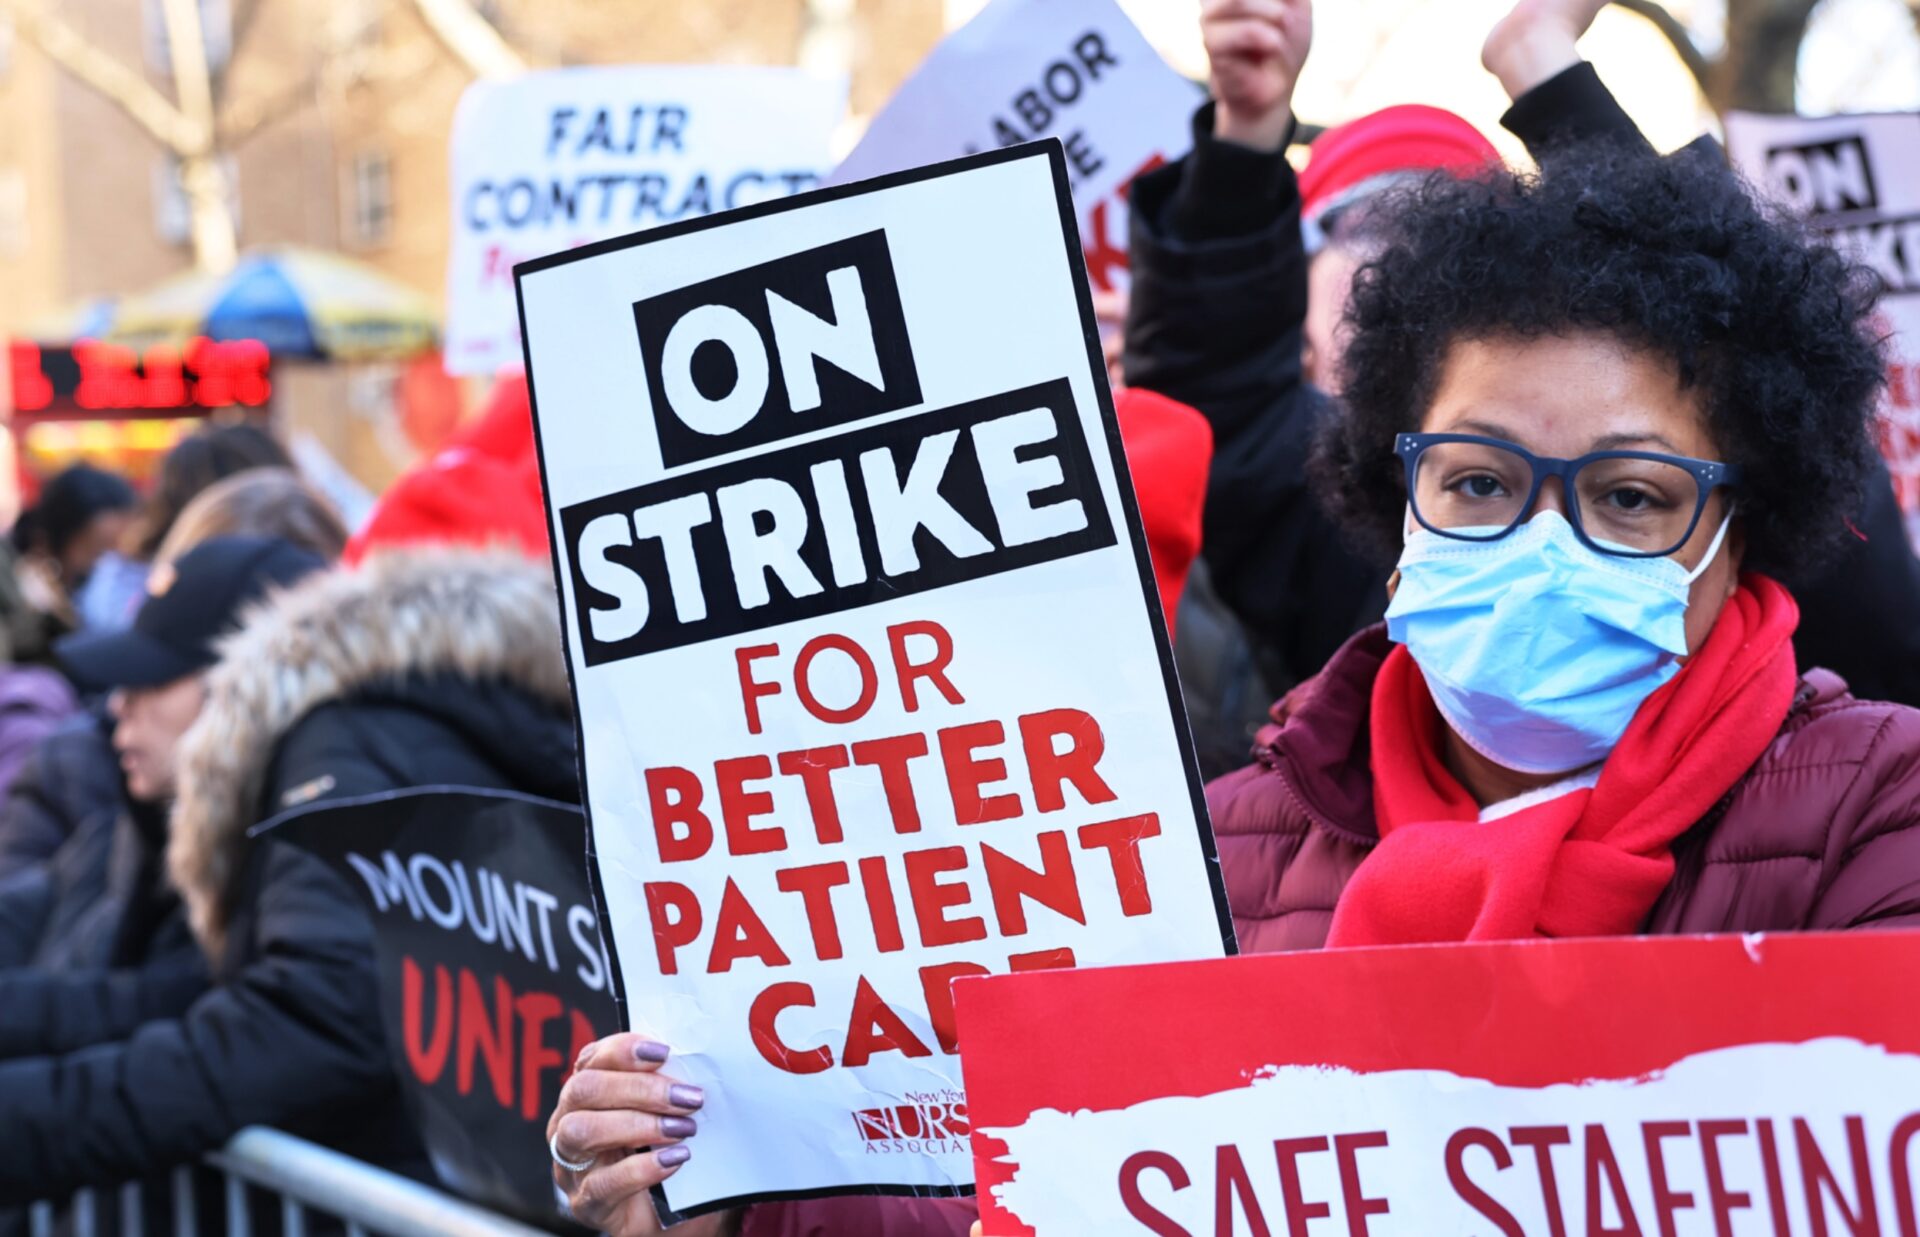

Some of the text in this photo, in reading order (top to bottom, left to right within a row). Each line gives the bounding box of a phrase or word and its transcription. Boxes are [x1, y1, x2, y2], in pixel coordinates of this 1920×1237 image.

[546, 104, 689, 155] FAIR
[967, 31, 1118, 154] ABOR
[661, 265, 886, 436] ON
[578, 406, 1089, 643] STRIKE
[735, 620, 966, 734] FOR
[644, 708, 1119, 863] BETTER
[345, 850, 617, 999] MOUNT S
[643, 812, 1162, 976] PATIENT
[749, 947, 1077, 1075] CA
[865, 1137, 971, 1154] ASSOCIA
[904, 1089, 940, 1103] New
[1117, 1130, 1390, 1237] SAFE
